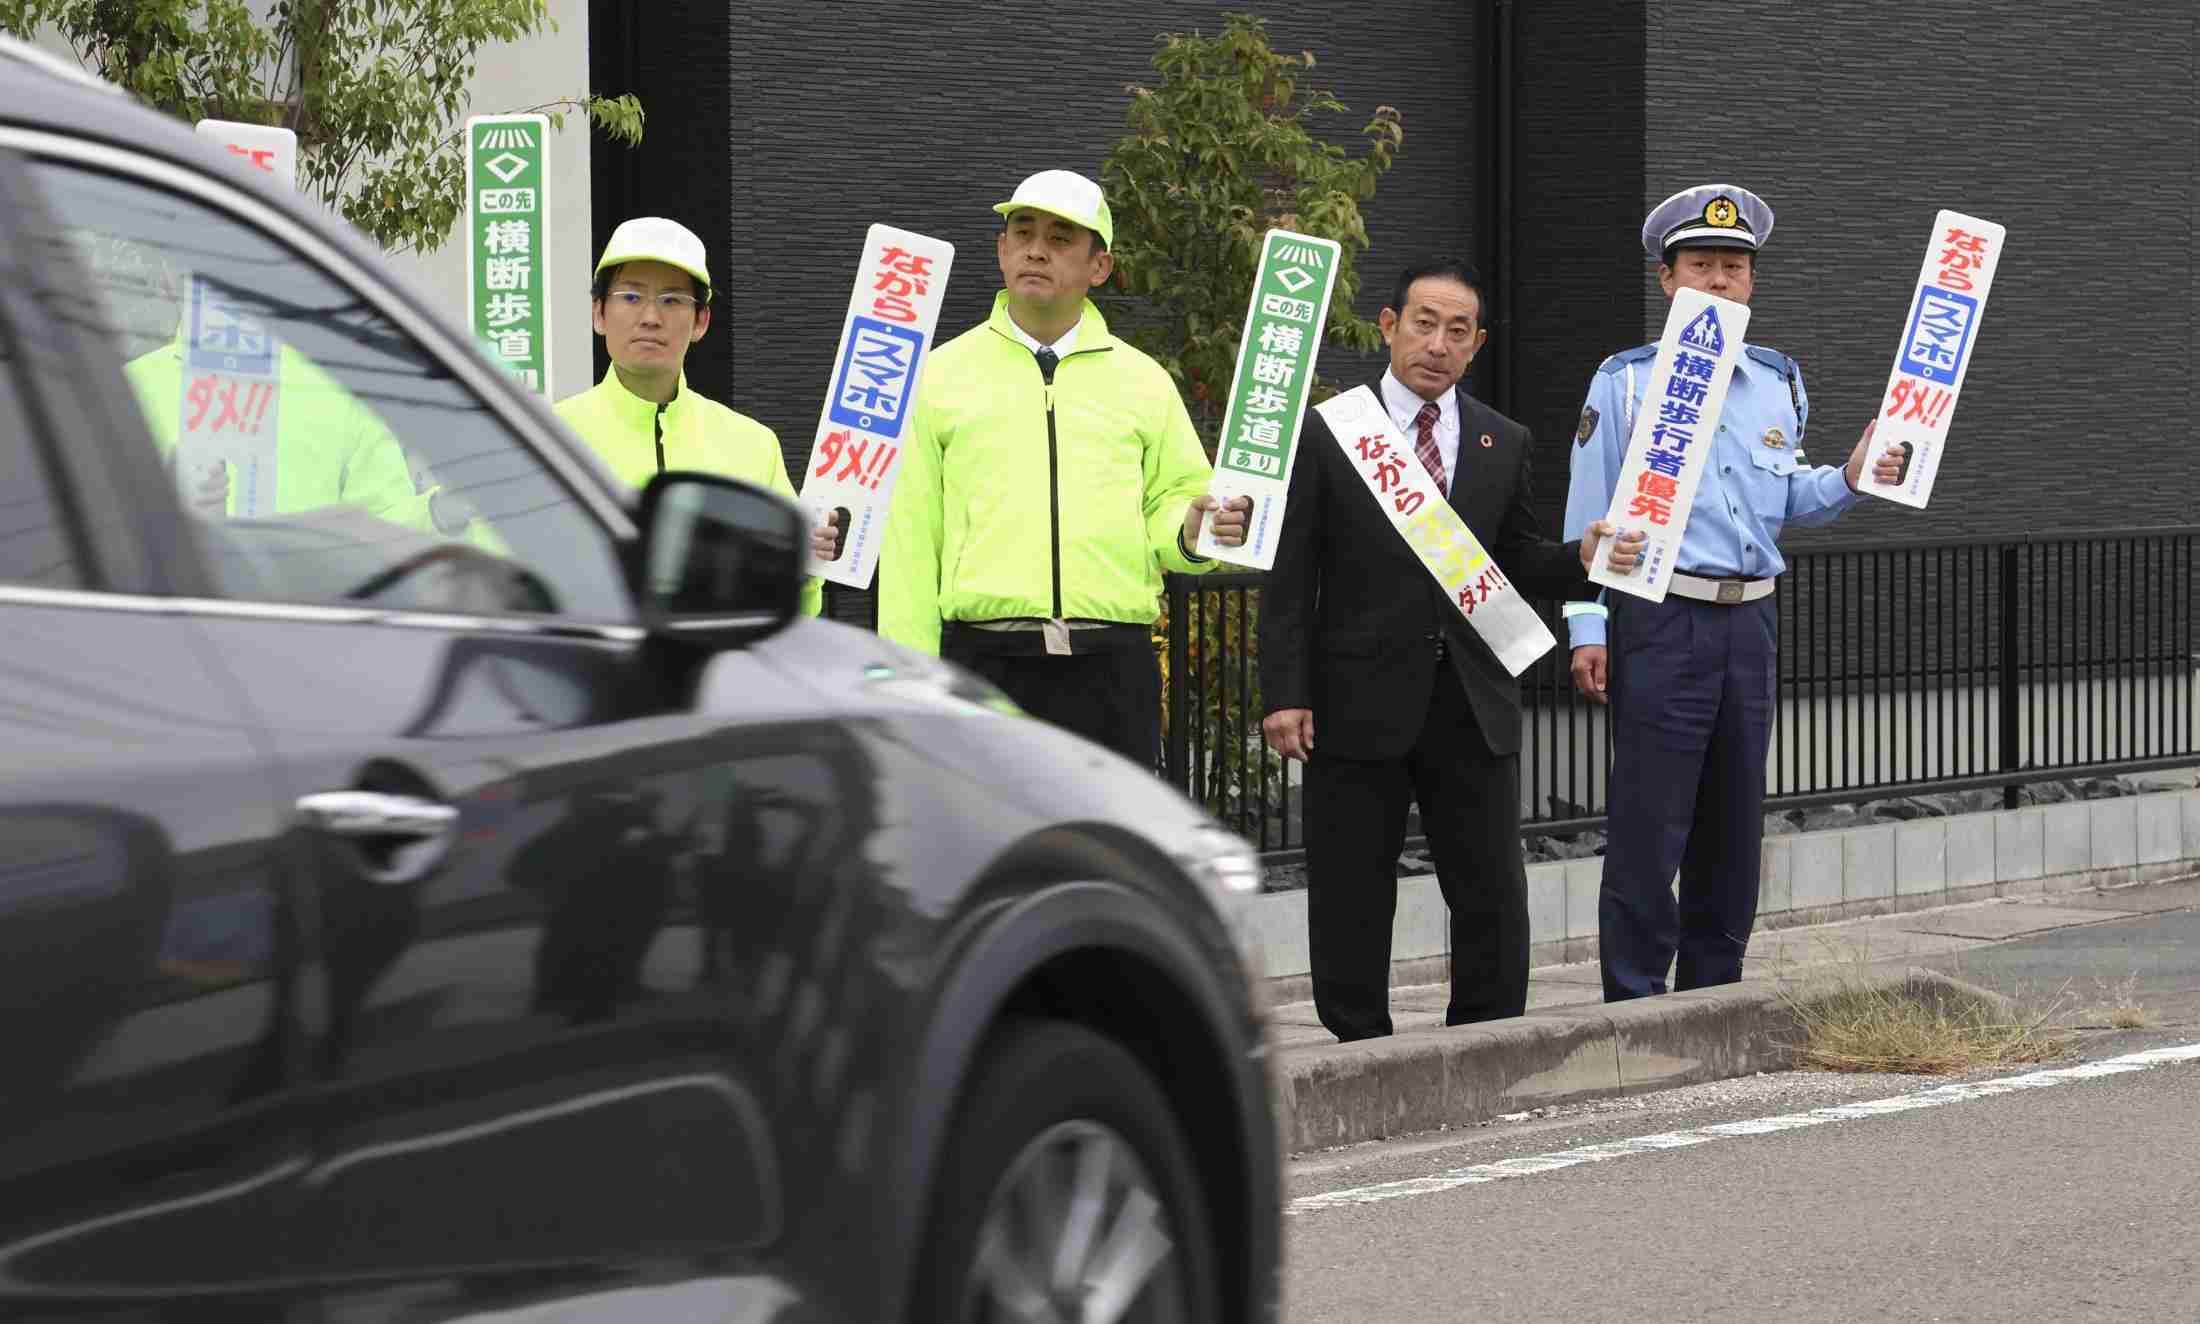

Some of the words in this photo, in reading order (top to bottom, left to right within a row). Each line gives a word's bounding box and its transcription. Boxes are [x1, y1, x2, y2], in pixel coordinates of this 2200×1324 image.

[484, 191, 532, 210] この先
[484, 219, 533, 361] 横断歩道
[871, 245, 933, 324] ながら
[1936, 228, 1987, 292] ながら
[1266, 296, 1311, 321] この先
[1912, 302, 1962, 365] スマホ
[187, 374, 273, 433] ダメ!!
[846, 334, 906, 413] スマホ
[1237, 321, 1304, 450] 横断歩道
[1887, 378, 1953, 429] ダメ!!
[815, 430, 898, 491] ダメ!!
[1236, 454, 1272, 472] あり
[1628, 351, 1717, 527] 横断歩行者優先
[1354, 434, 1425, 516] ながら
[1458, 565, 1508, 615] ダメ!!
